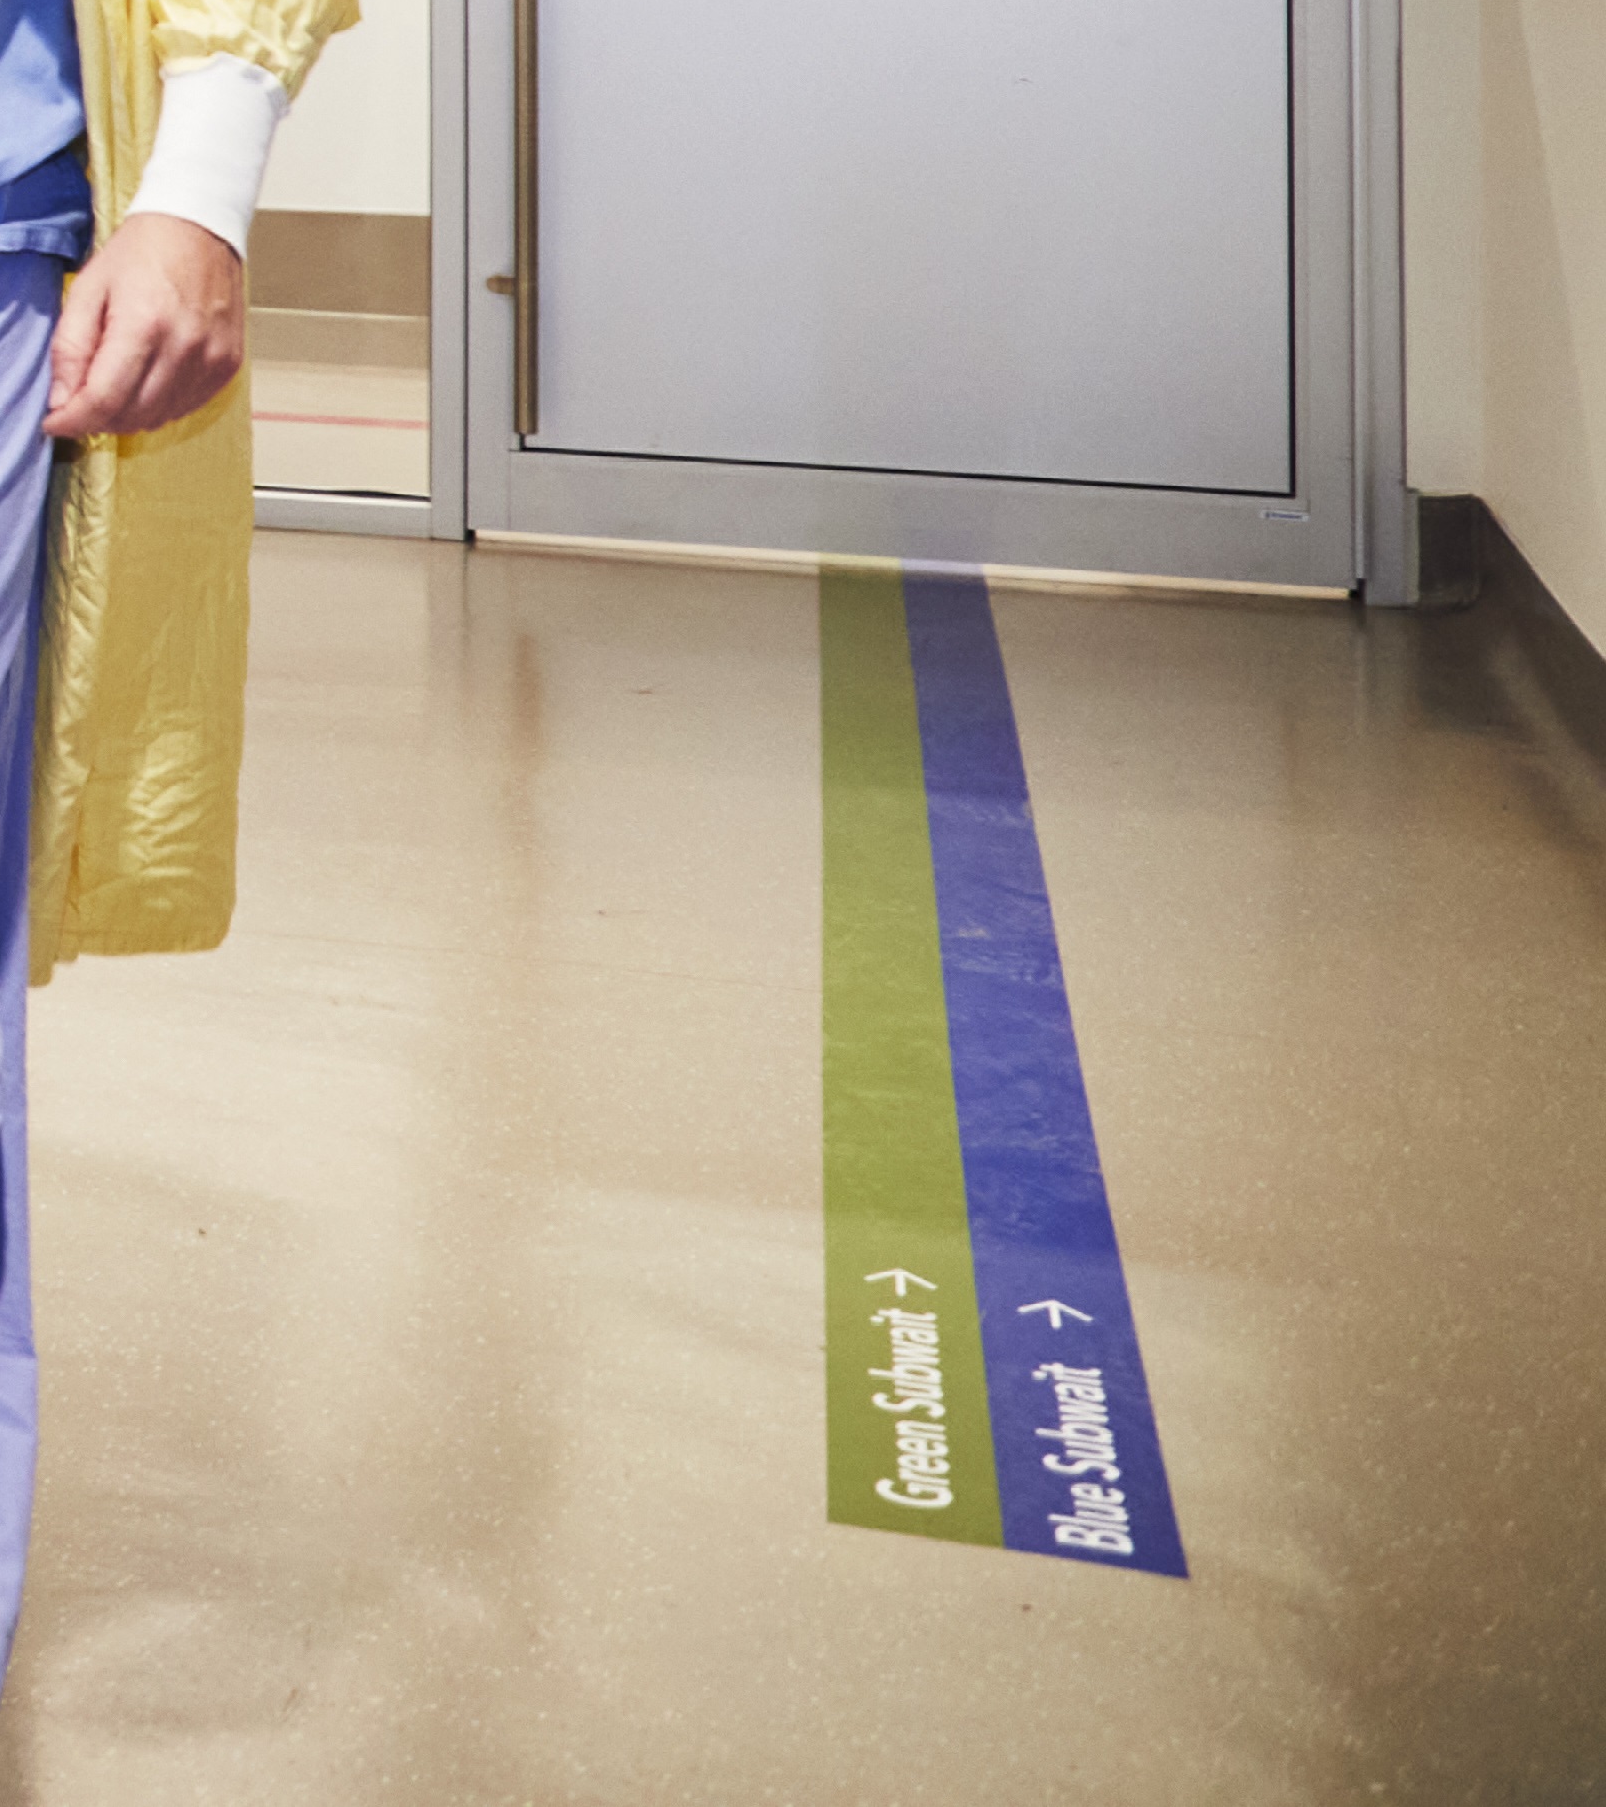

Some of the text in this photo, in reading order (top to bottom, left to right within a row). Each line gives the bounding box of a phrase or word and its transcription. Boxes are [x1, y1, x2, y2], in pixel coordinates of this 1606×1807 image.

[867, 1307, 953, 1510] Green Subwait
[1031, 1362, 1135, 1556] Blue Subwait
